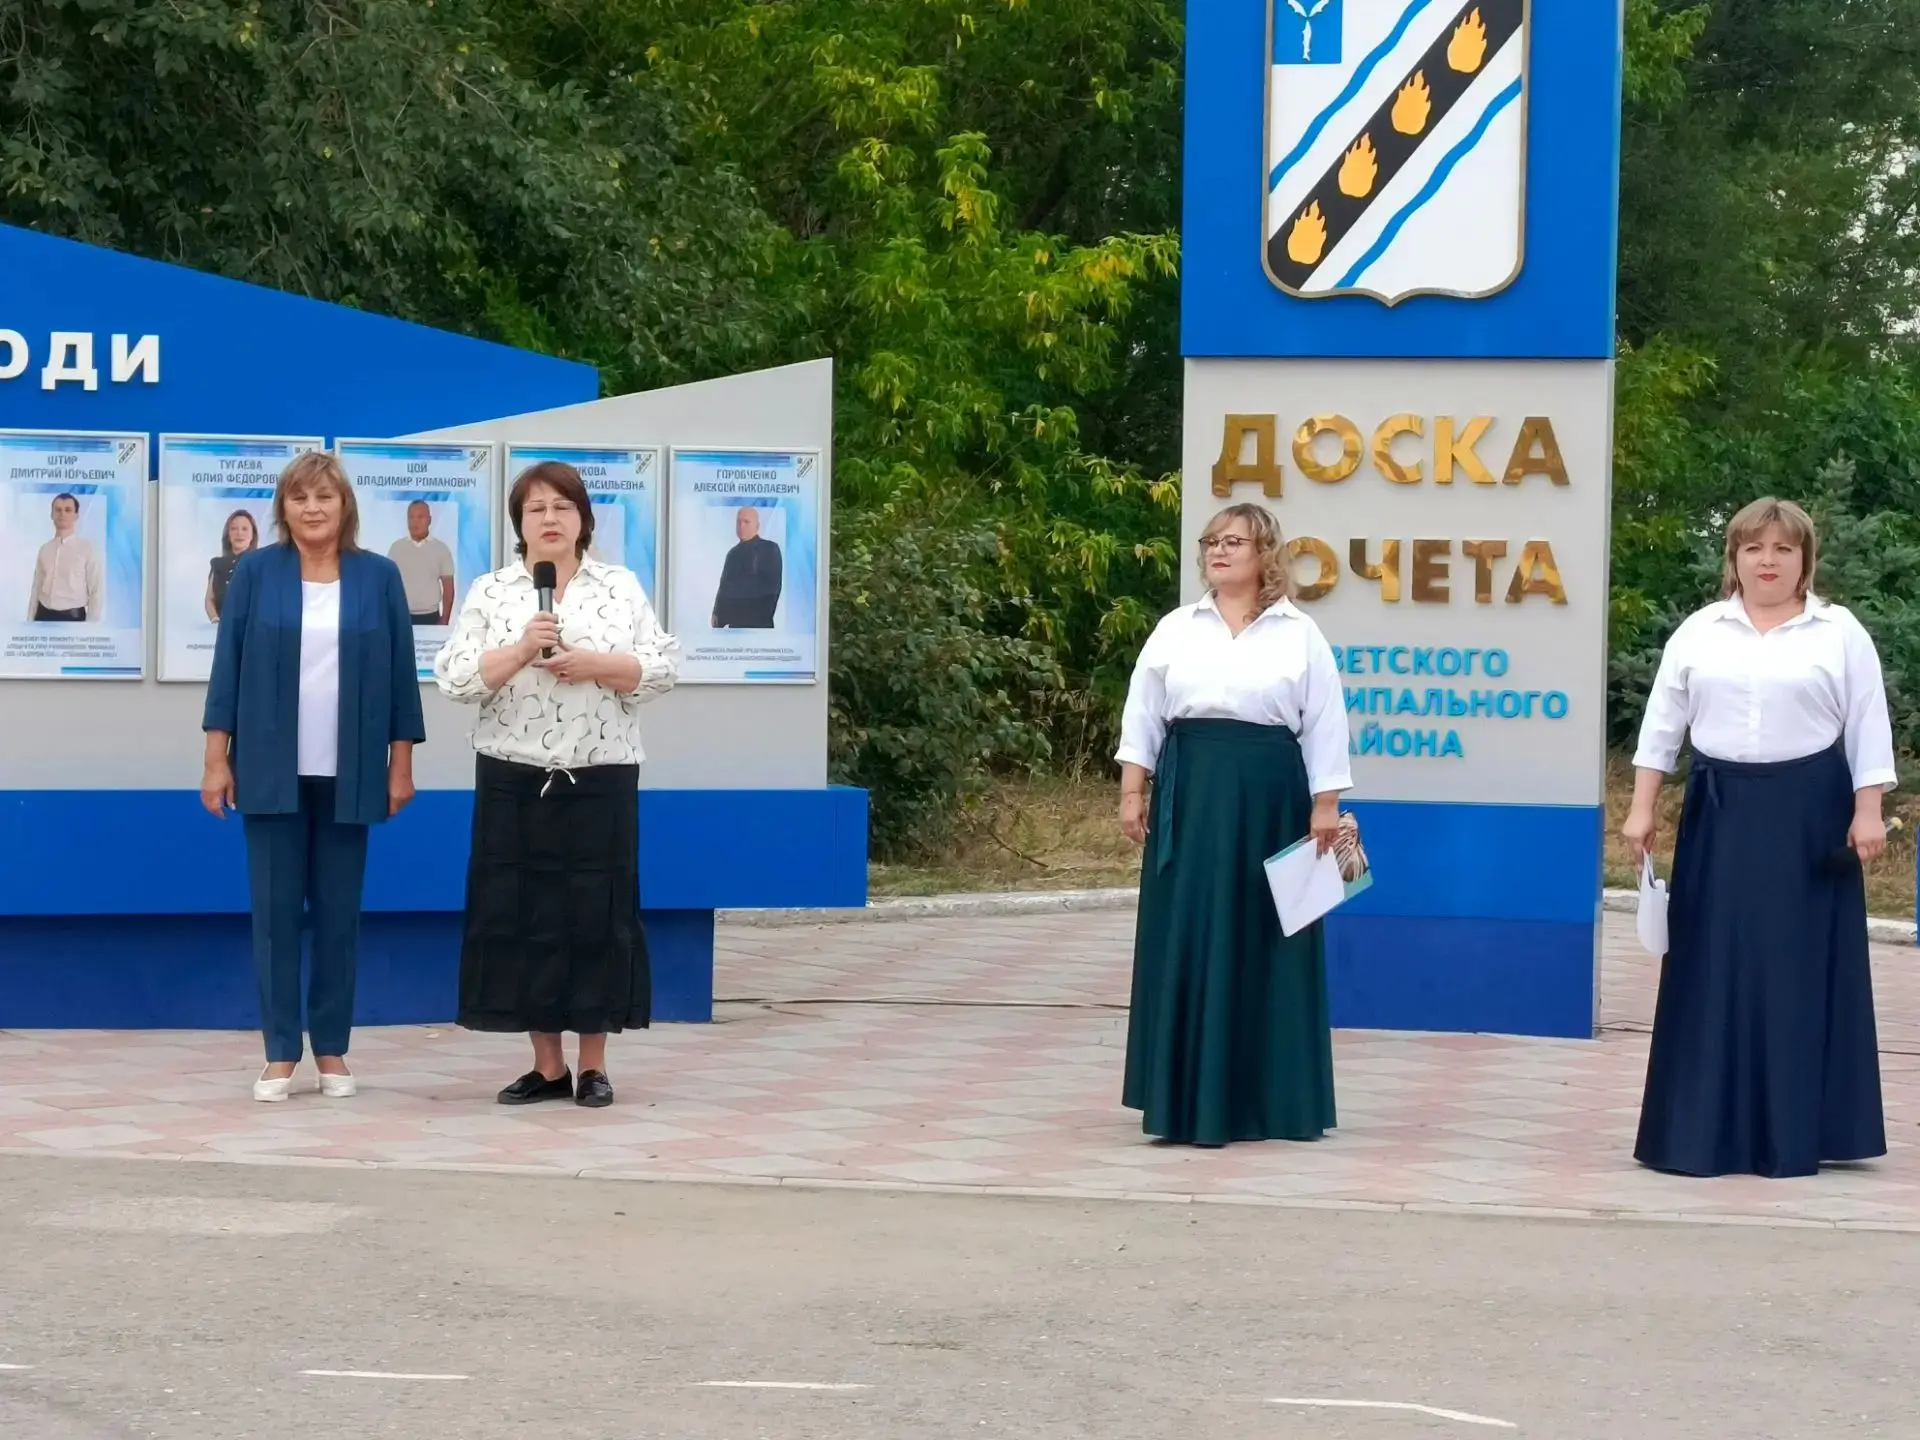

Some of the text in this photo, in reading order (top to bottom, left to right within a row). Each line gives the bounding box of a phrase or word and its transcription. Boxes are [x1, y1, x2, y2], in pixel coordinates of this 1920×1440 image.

[47, 455, 78, 465] ШТИР
[1211, 413, 1571, 498] ДОСКА
[219, 459, 263, 470] ТУГАЕВА
[406, 462, 428, 473] ЦОЙ
[10, 468, 115, 480] ДМИТРИЙ ЮРЬЕВИЧ
[192, 472, 223, 483] ЮЛИЯ
[356, 475, 476, 488] ВЛАДИМИР РОМАНОВИЧ
[693, 482, 800, 494] АЛЕКСЕЙ НИКОЛАЕВИЧ
[1284, 536, 1569, 605] ОЧЕТА
[1331, 645, 1509, 678] ЕТСКОГО
[1343, 686, 1569, 719] ИПАЛЬНОГО
[1349, 720, 1465, 757] ЙОНА
